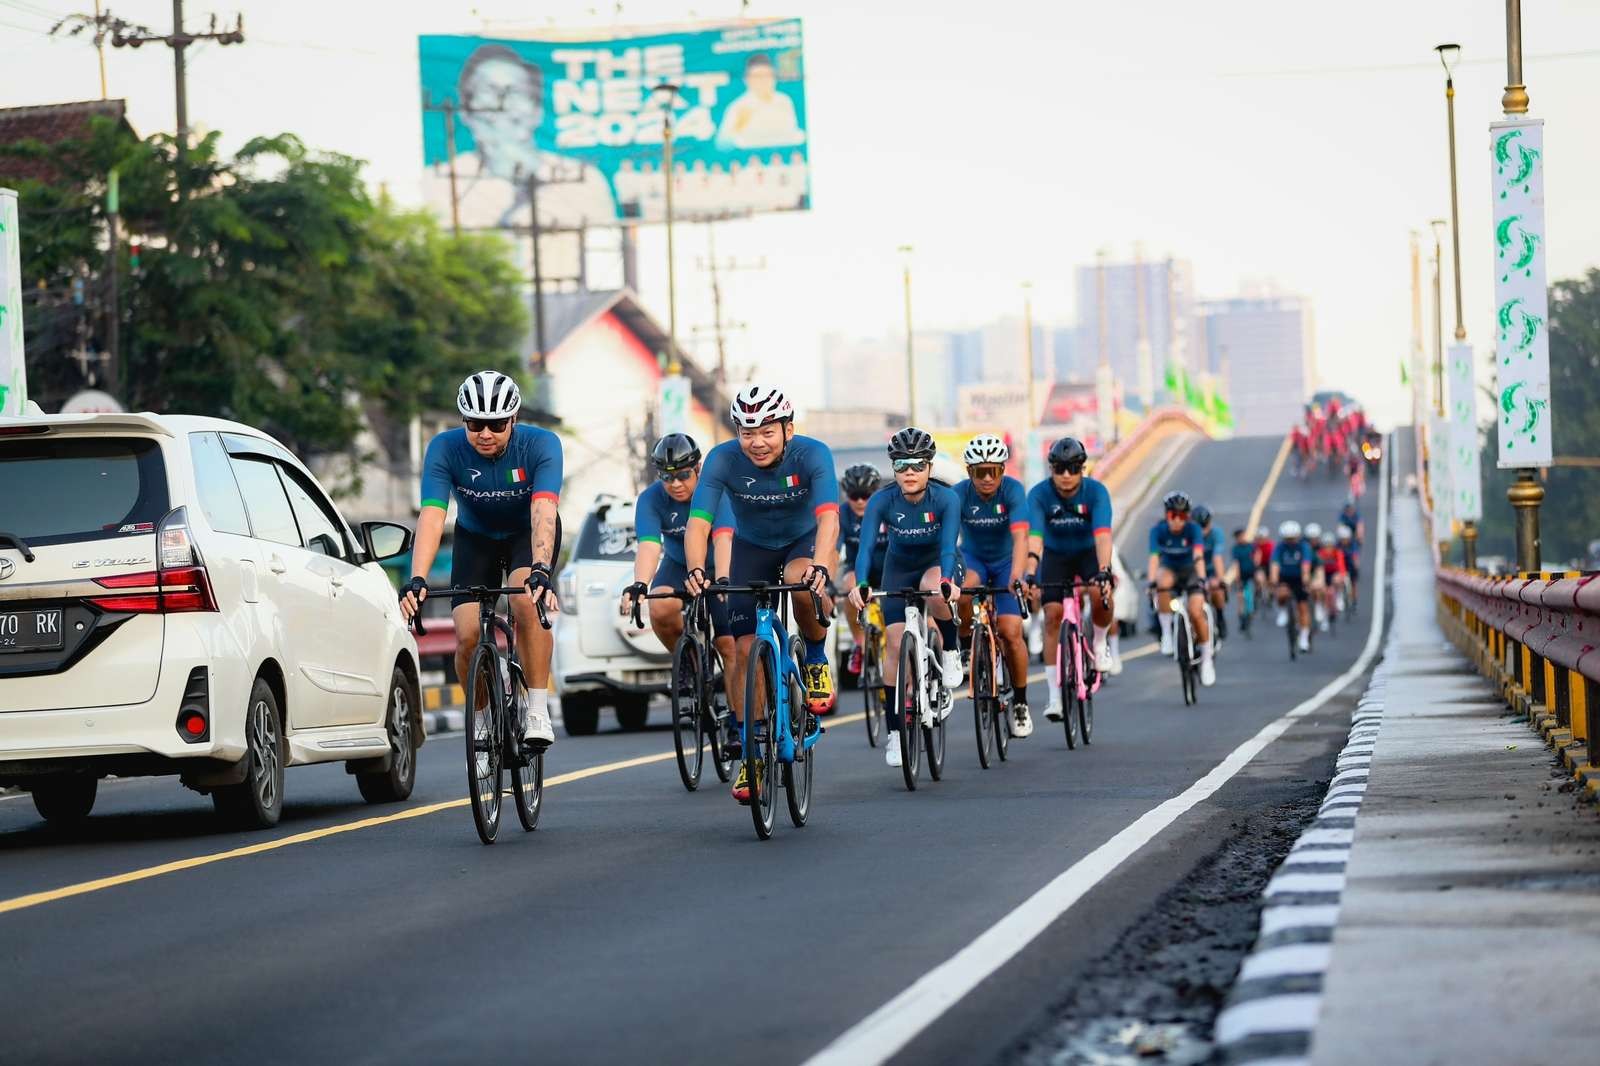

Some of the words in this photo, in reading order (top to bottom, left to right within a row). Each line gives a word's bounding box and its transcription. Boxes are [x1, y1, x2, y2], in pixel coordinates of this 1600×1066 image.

[551, 44, 684, 81] THE
[553, 71, 730, 113] NEXT
[555, 104, 717, 148] 2024
[36, 612, 57, 634] RK
